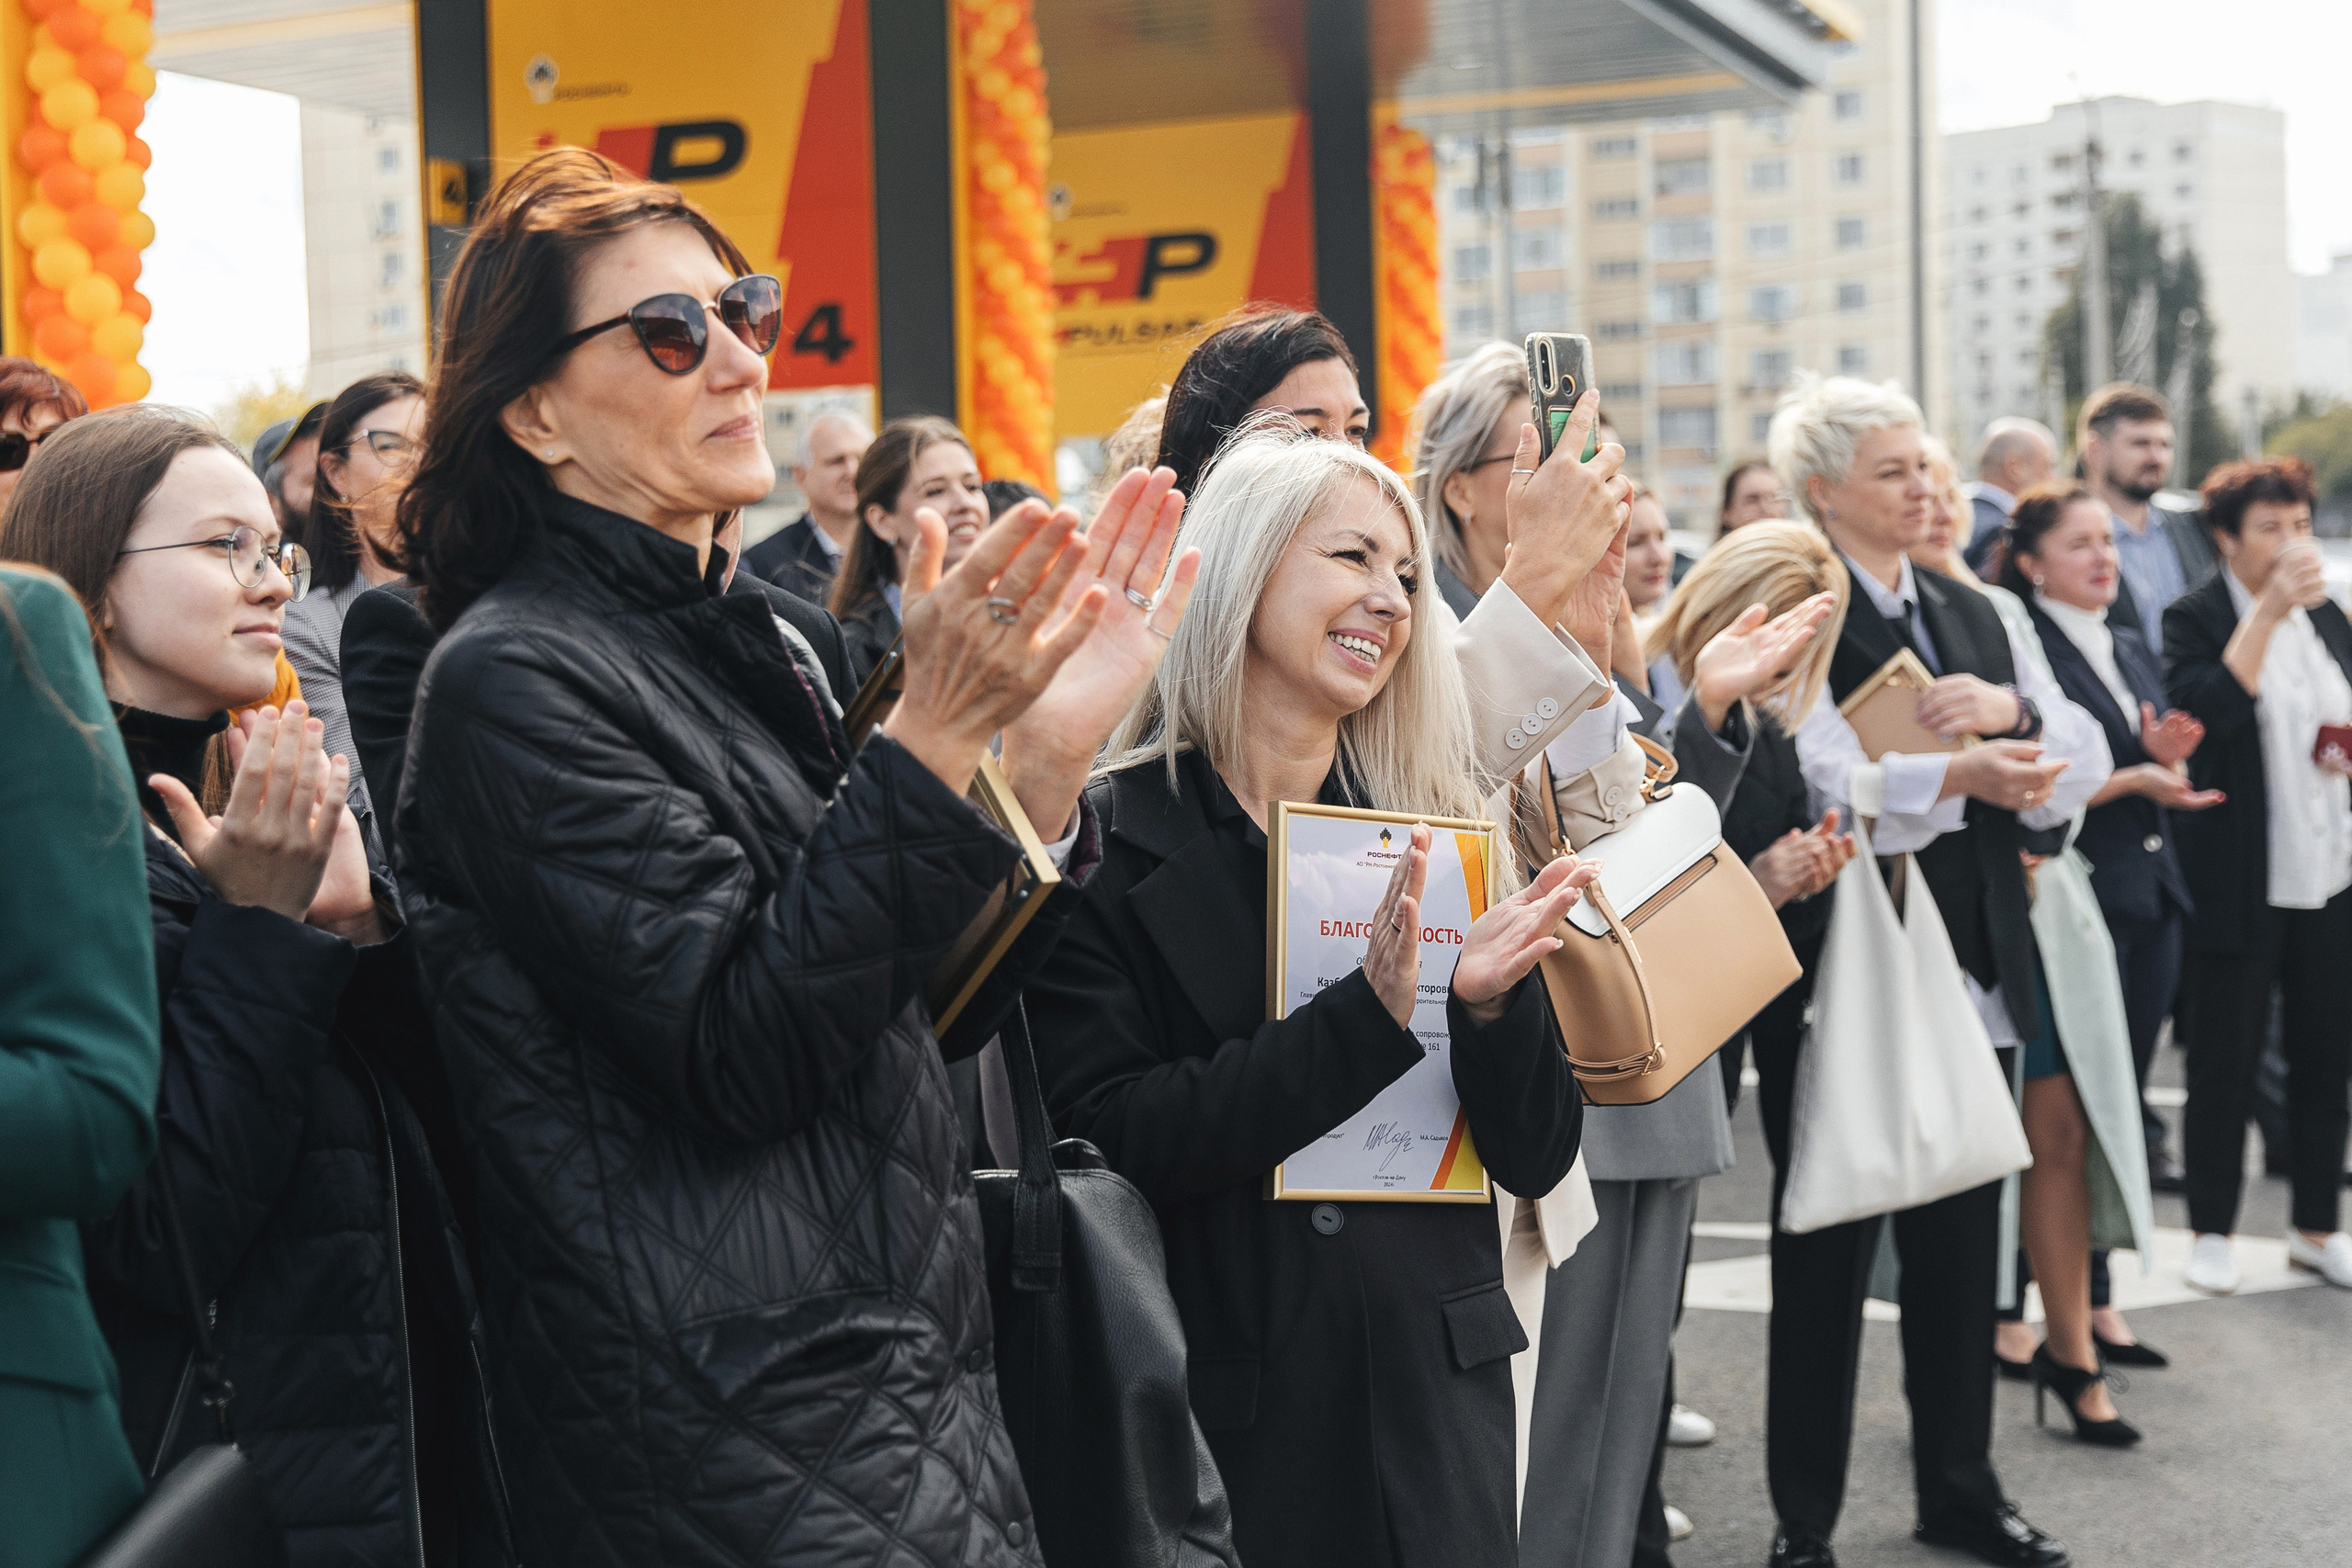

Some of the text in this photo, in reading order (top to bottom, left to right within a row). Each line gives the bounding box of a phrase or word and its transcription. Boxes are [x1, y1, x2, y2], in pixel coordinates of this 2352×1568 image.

[794, 303, 854, 361] 4
[1416, 1031, 1451, 1039] сопровож
[1428, 1043, 1440, 1051] 161
